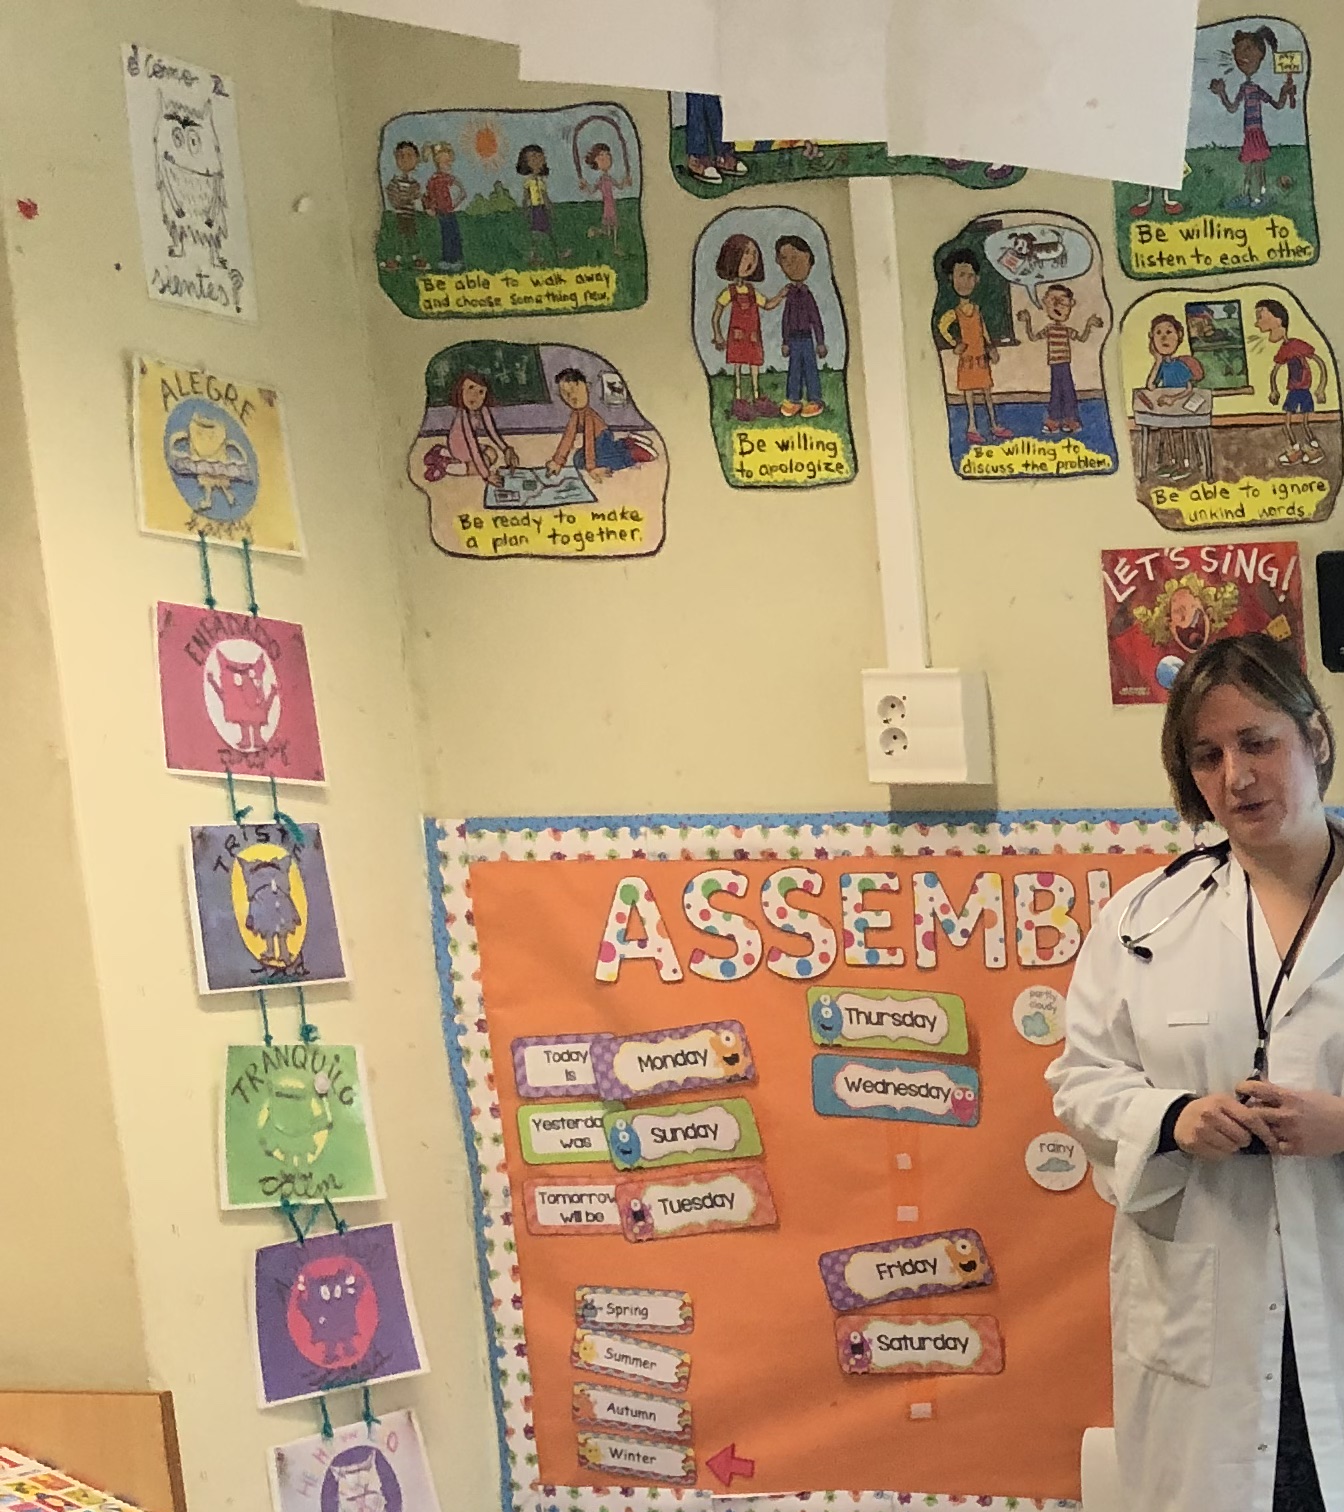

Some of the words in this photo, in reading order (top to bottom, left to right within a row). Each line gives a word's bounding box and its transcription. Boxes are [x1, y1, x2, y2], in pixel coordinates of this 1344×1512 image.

[1136, 224, 1168, 245] Be
[1179, 217, 1248, 248] willing
[1265, 218, 1289, 239] to
[1134, 252, 1187, 269] listen
[1191, 248, 1212, 267] to
[1219, 247, 1260, 266] each
[422, 276, 447, 292] Be
[455, 275, 491, 291] able
[501, 275, 519, 288] to
[530, 272, 567, 287] walk
[575, 272, 611, 289] away
[422, 294, 450, 310] and
[455, 294, 502, 309] choose
[737, 432, 766, 456] Be
[775, 430, 839, 459] willing
[972, 446, 994, 459] Be
[1004, 438, 1058, 462] willing
[1064, 439, 1081, 455] to
[735, 464, 754, 480] to
[759, 458, 849, 481] apologize.
[961, 460, 1015, 476] discuss
[1022, 459, 1049, 474] the
[1151, 487, 1180, 506] Be
[1189, 483, 1231, 502] able
[1238, 484, 1261, 499] to
[1271, 479, 1328, 501] ignore
[457, 513, 485, 531] Be
[491, 511, 544, 534] ready
[553, 508, 577, 525] to
[590, 506, 644, 523] make
[1188, 503, 1246, 524] unkind
[465, 535, 479, 550] a
[491, 533, 530, 554] plan
[1102, 546, 1191, 603] LET'S
[845, 1007, 938, 1033] Thursday
[543, 1049, 589, 1065] Today
[637, 1049, 709, 1073] Monday
[844, 1076, 952, 1103] Wednesday
[531, 1116, 605, 1132] Yesterda
[650, 1123, 719, 1145] Sunday
[560, 1136, 592, 1149] was
[1039, 1141, 1075, 1157] rainy
[585, 1210, 605, 1223] be
[875, 1254, 940, 1283] Friday
[606, 1302, 650, 1320] Spring
[876, 1330, 971, 1357] Saturday
[604, 1347, 657, 1371] Summer
[606, 1402, 657, 1423] Autumn
[608, 1446, 657, 1465] Winter
